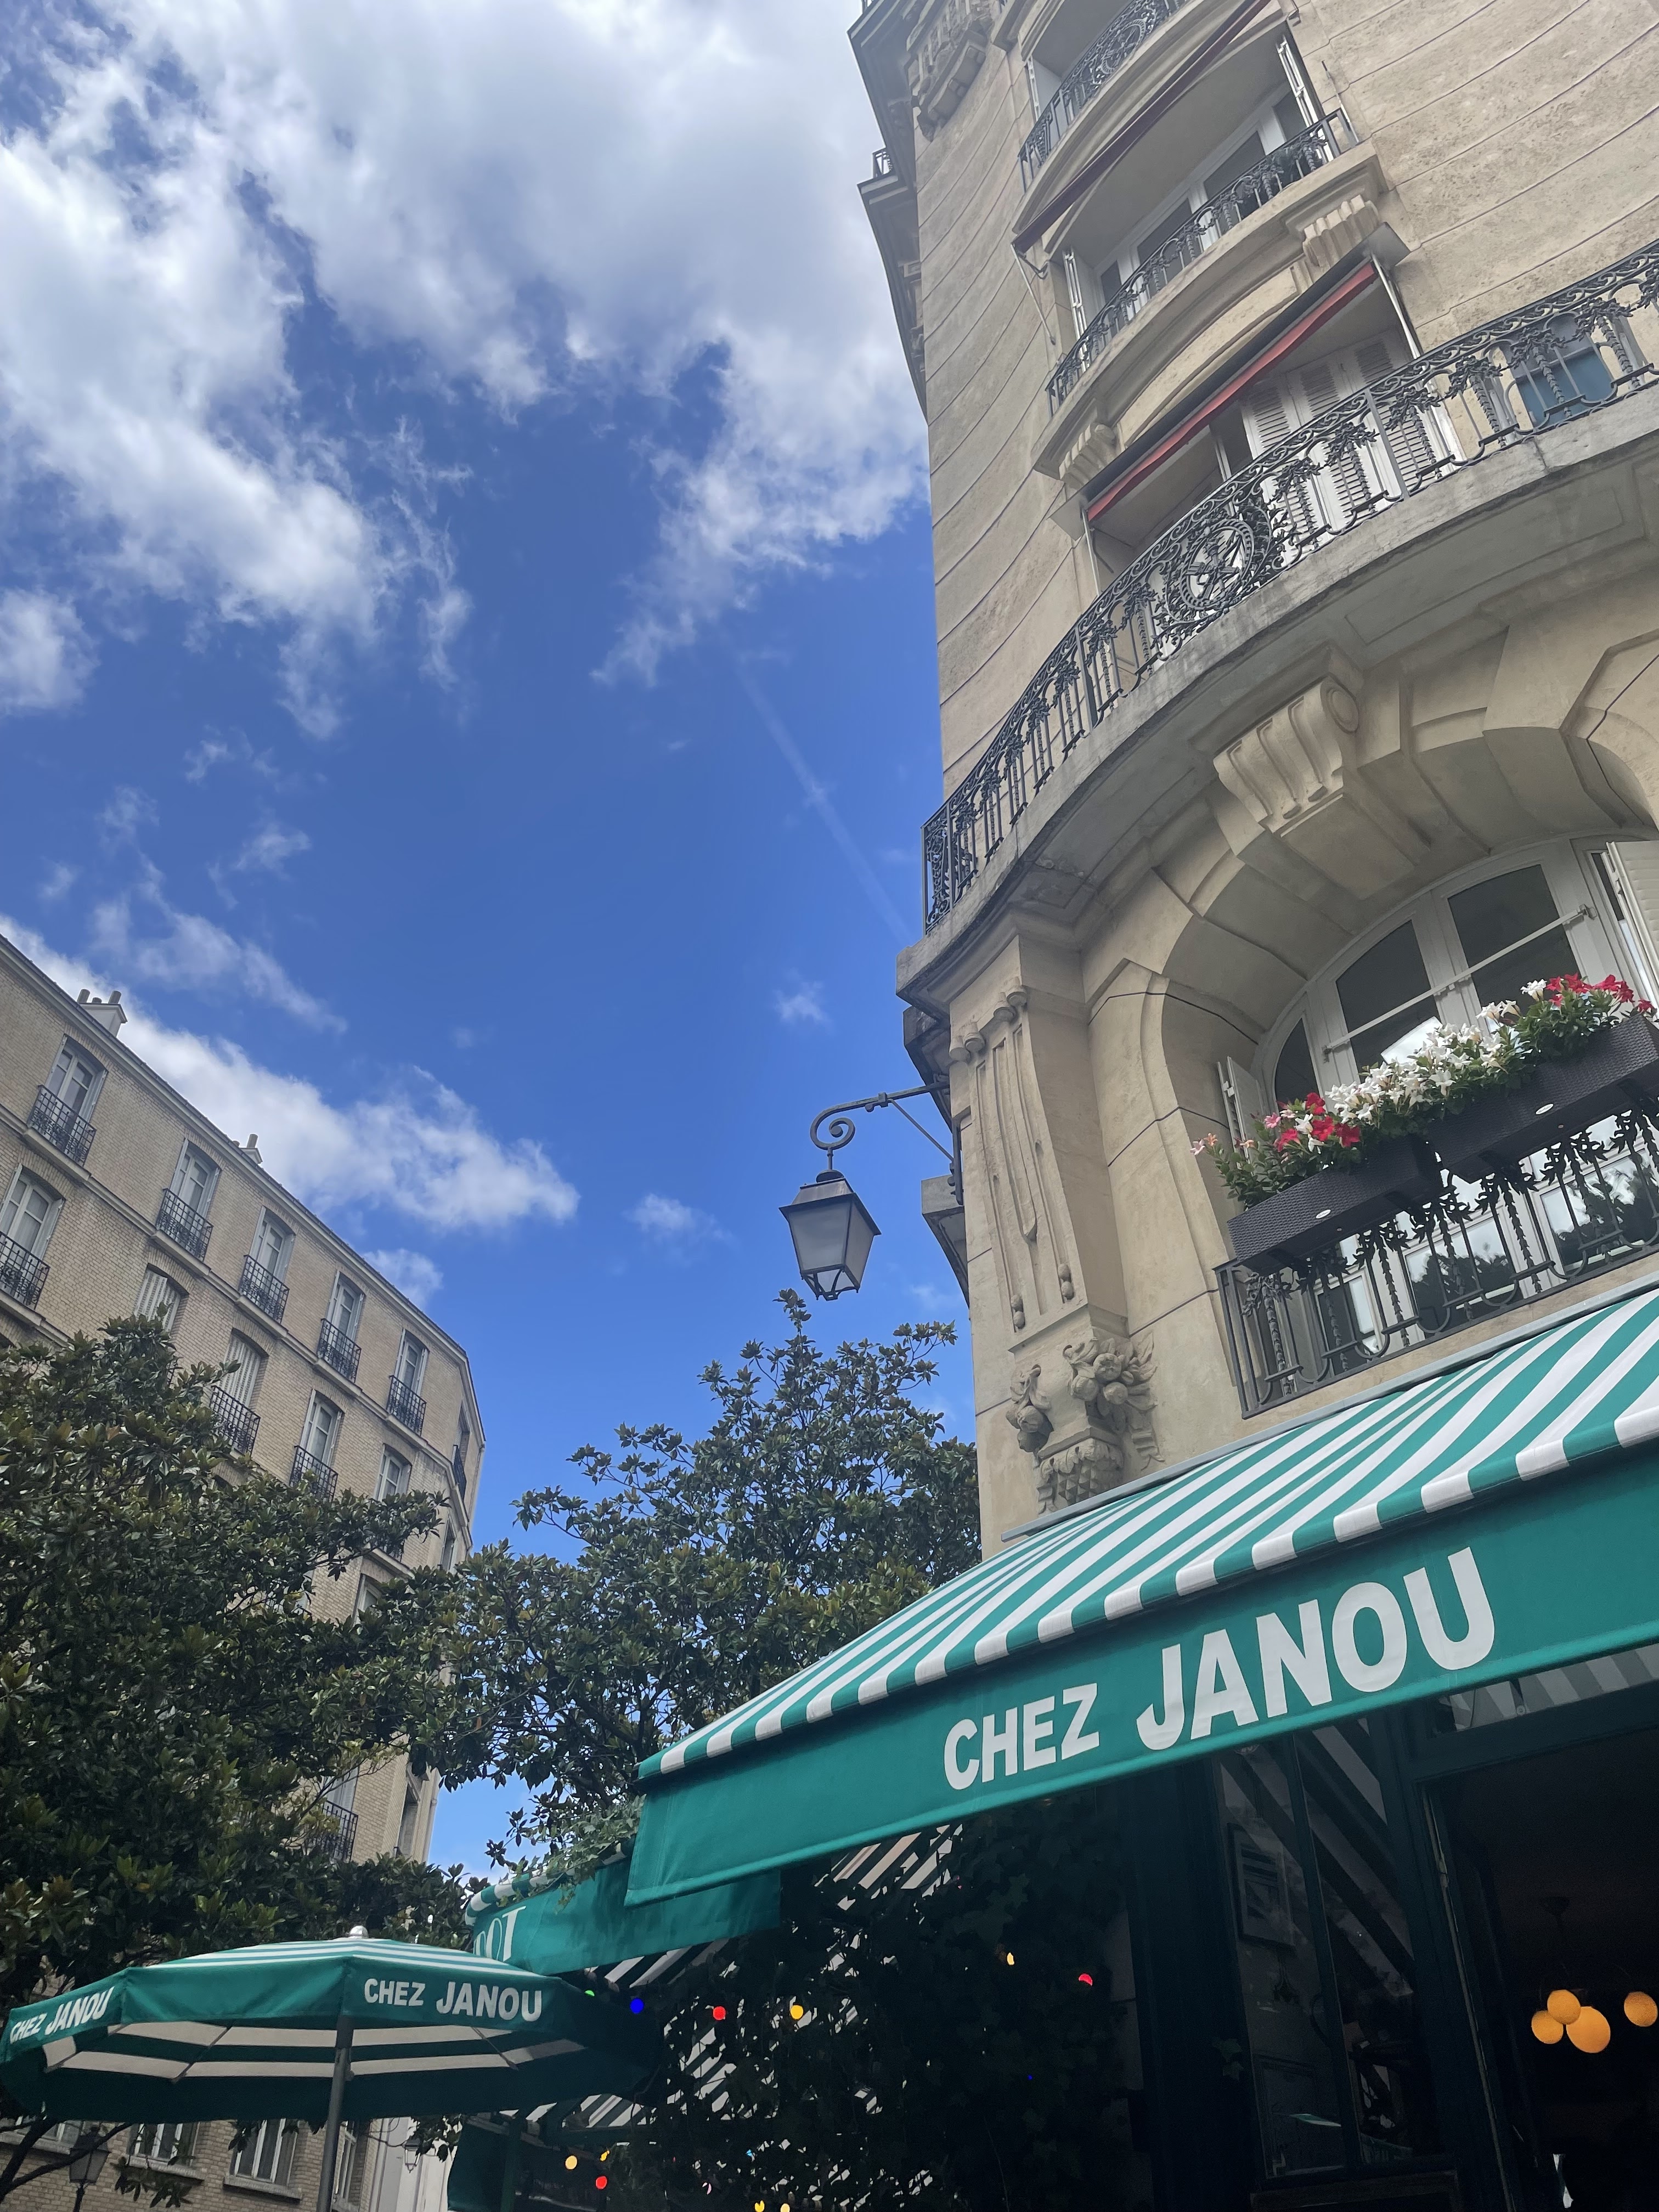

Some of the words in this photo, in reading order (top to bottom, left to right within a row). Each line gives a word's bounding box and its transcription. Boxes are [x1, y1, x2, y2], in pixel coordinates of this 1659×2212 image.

[944, 1683, 1100, 1790] CHEZ
[1136, 1546, 1495, 1751] JANOU
[10, 2012, 48, 2044] CHEZ
[44, 1986, 115, 2035] JANOU
[364, 1978, 425, 2006] CHEZ
[436, 1981, 543, 2021] JANOU
